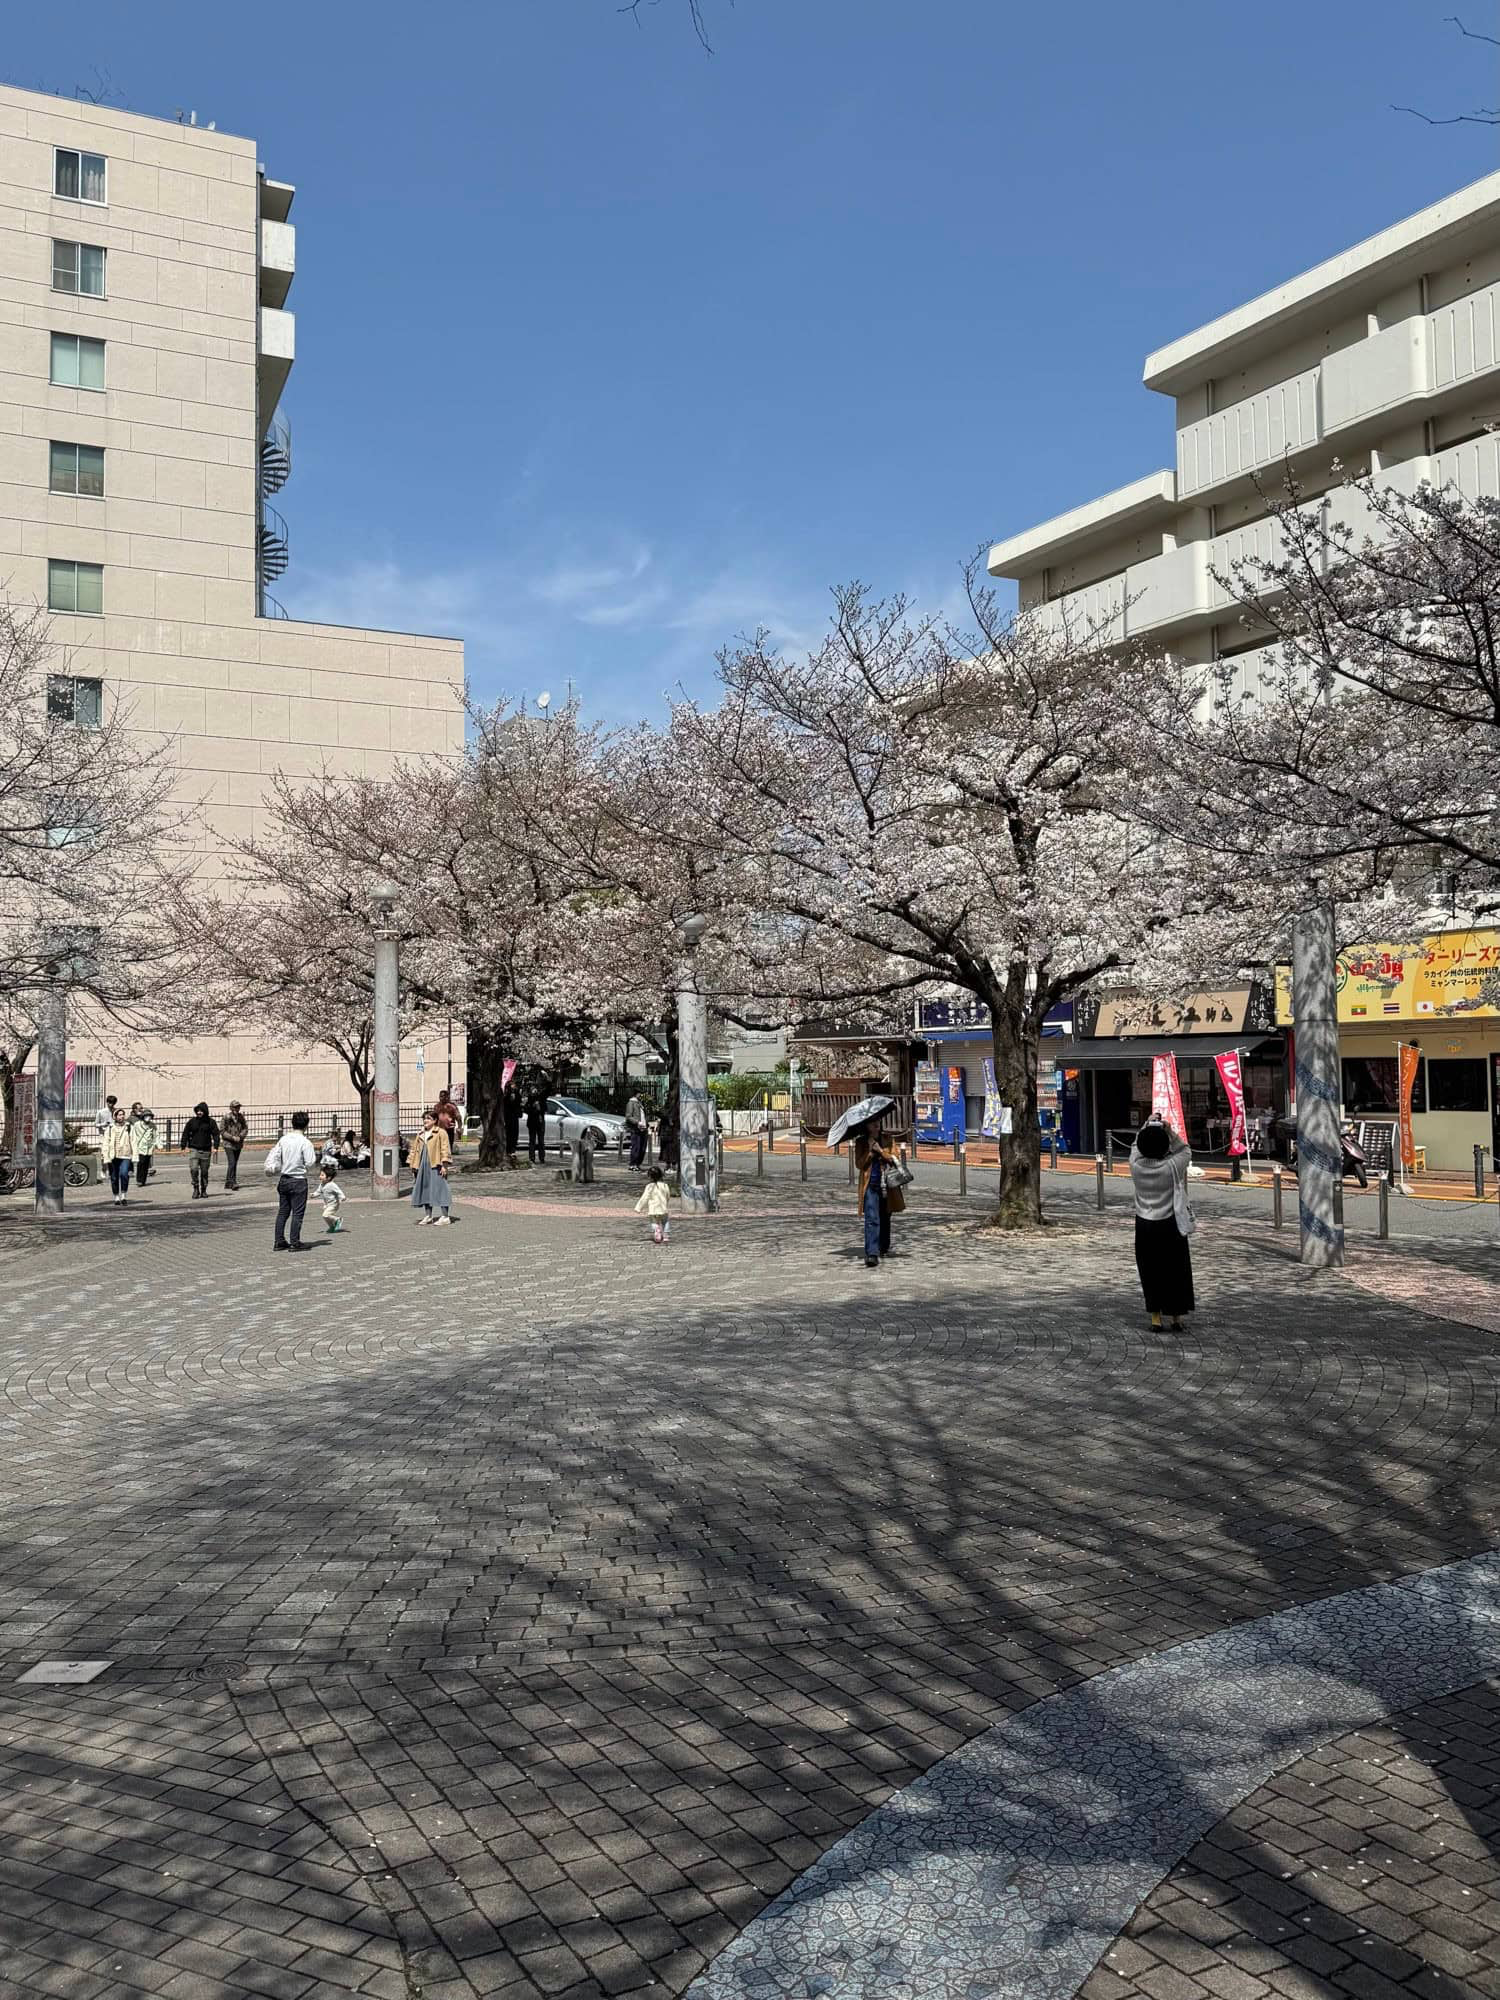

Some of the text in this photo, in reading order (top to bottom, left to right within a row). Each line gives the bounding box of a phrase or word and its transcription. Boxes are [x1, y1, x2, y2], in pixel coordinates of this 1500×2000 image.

[1430, 976, 1497, 987] ミャンマーレストラン
